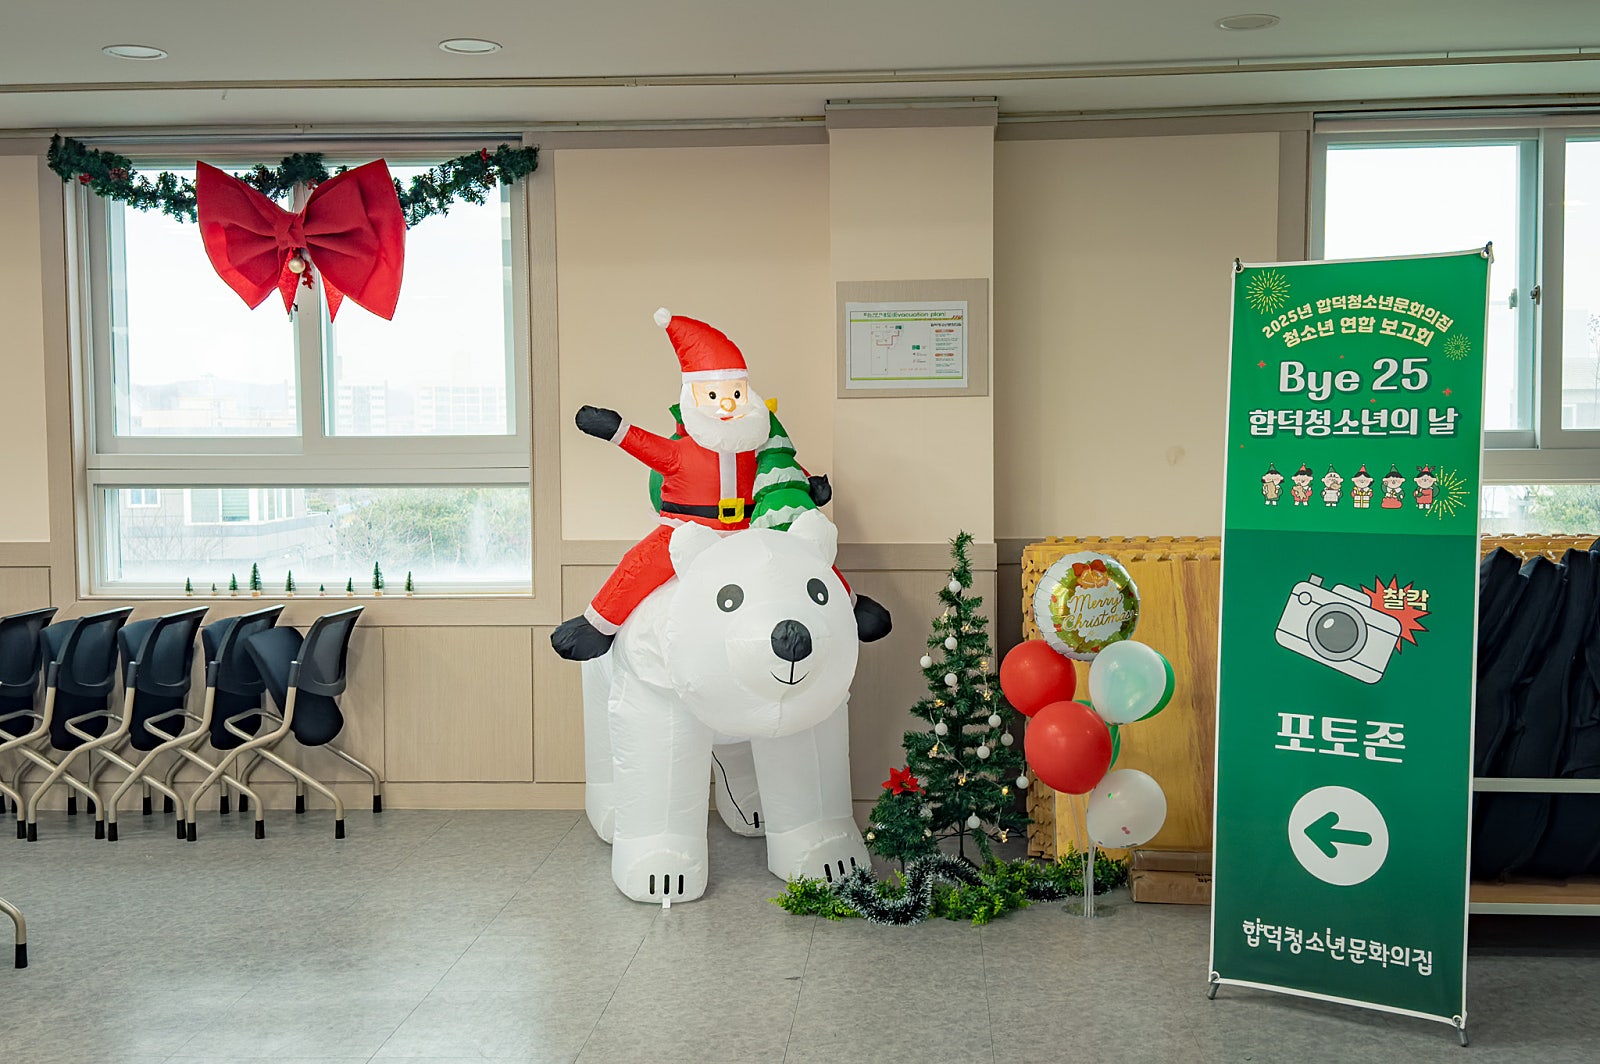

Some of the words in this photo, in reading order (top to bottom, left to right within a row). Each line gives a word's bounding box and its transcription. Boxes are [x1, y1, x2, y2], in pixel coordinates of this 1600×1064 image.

[1262, 302, 1314, 339] 2025년
[1315, 294, 1454, 333] 합덕청소년문화의집
[1282, 319, 1335, 348] 청소년
[1340, 316, 1376, 334] 연합
[1379, 317, 1435, 347] 보고회
[1279, 360, 1361, 401] Bye
[1371, 357, 1430, 391] 25
[1248, 408, 1419, 437] 합덕청소년의
[1428, 406, 1459, 436] 날
[1068, 593, 1124, 613] Merry
[1382, 587, 1430, 611] 찰칵
[1063, 610, 1134, 631] Christmas
[1274, 712, 1406, 763] 포토존
[1242, 917, 1433, 976] 합덕청소년문화의집
